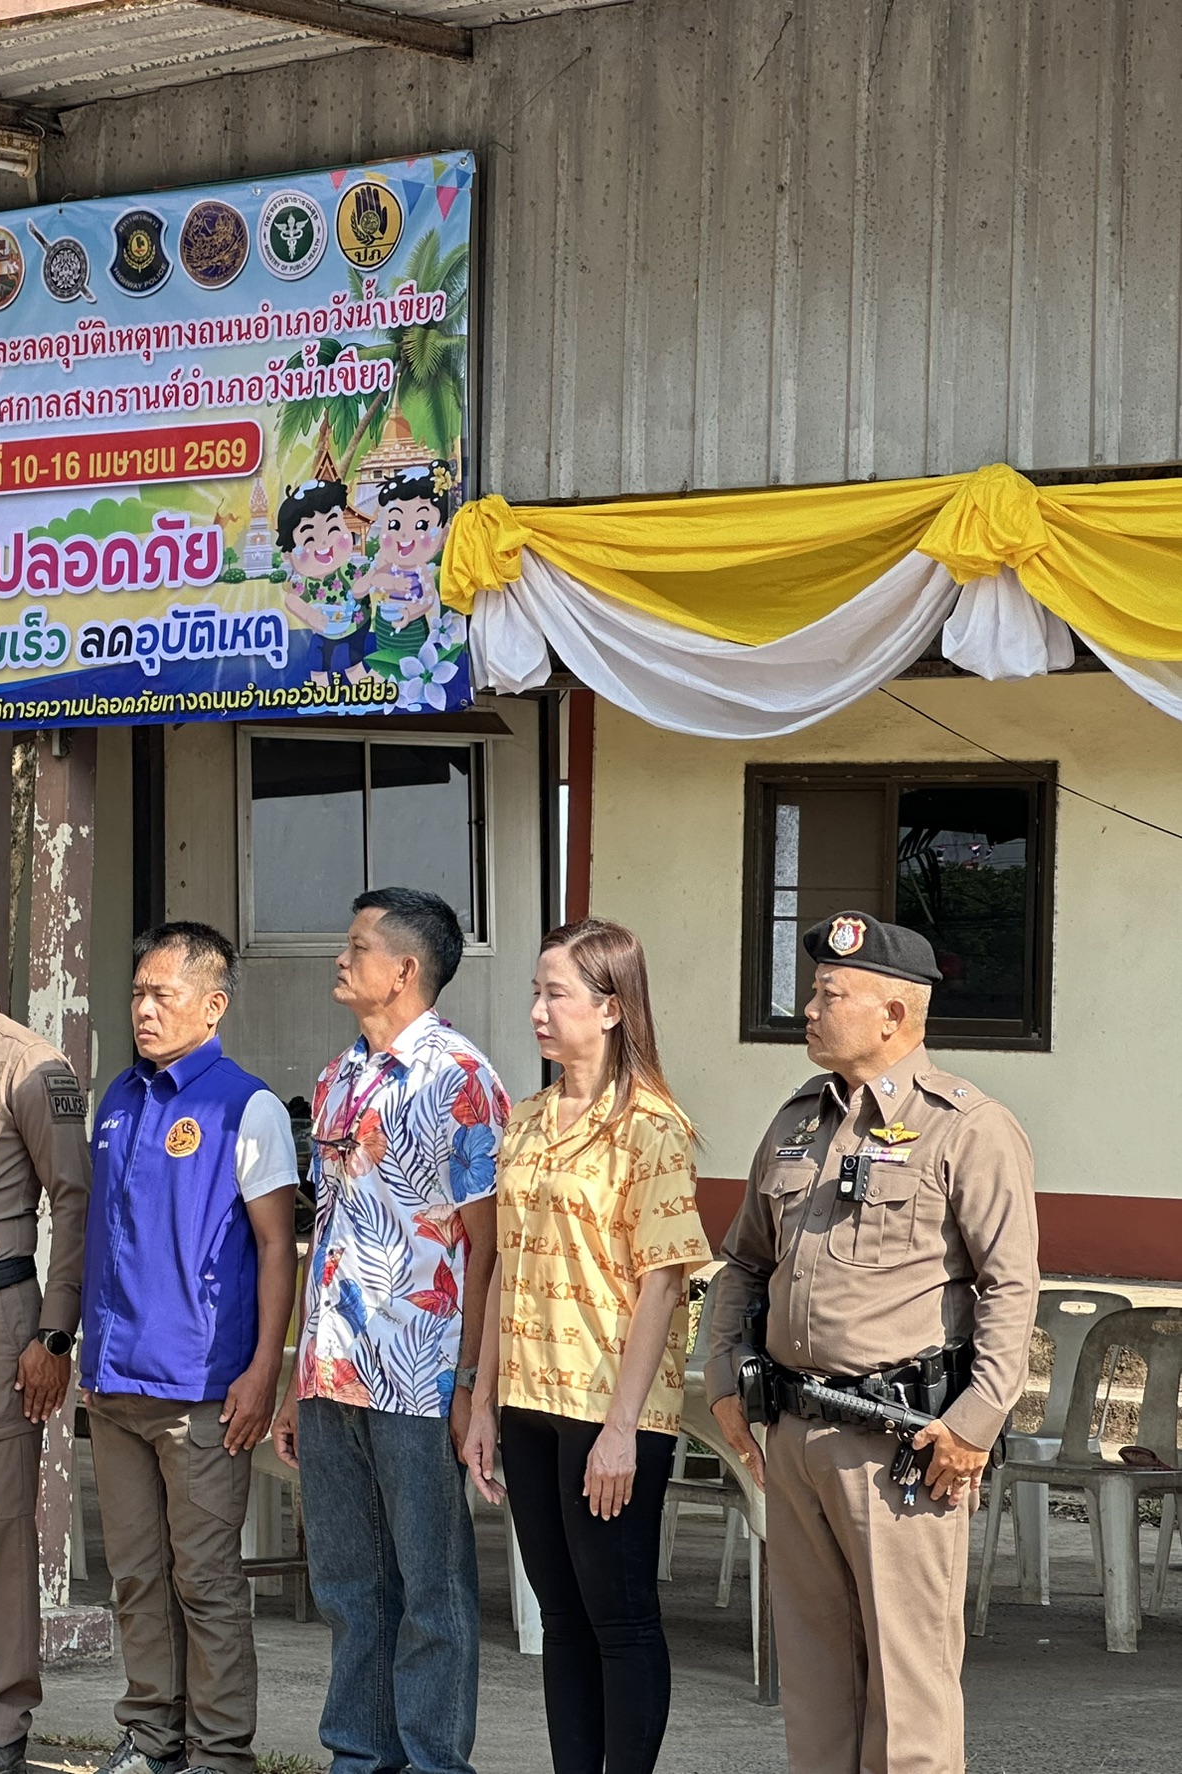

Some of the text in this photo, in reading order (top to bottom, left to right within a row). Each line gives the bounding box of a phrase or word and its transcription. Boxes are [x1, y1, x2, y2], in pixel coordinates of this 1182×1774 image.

[264, 244, 281, 268] MINISTRY
[289, 261, 308, 272] PUBLIC
[308, 238, 321, 261] HEALTH
[113, 267, 143, 290] HIGHWAY
[144, 262, 168, 288] POLICE
[11, 451, 80, 484] 10-16
[88, 446, 176, 479] เมษายน
[184, 441, 248, 472] 2569
[80, 608, 285, 671] ลดอุบัติเหตุ
[55, 1096, 85, 1113] POLICE
